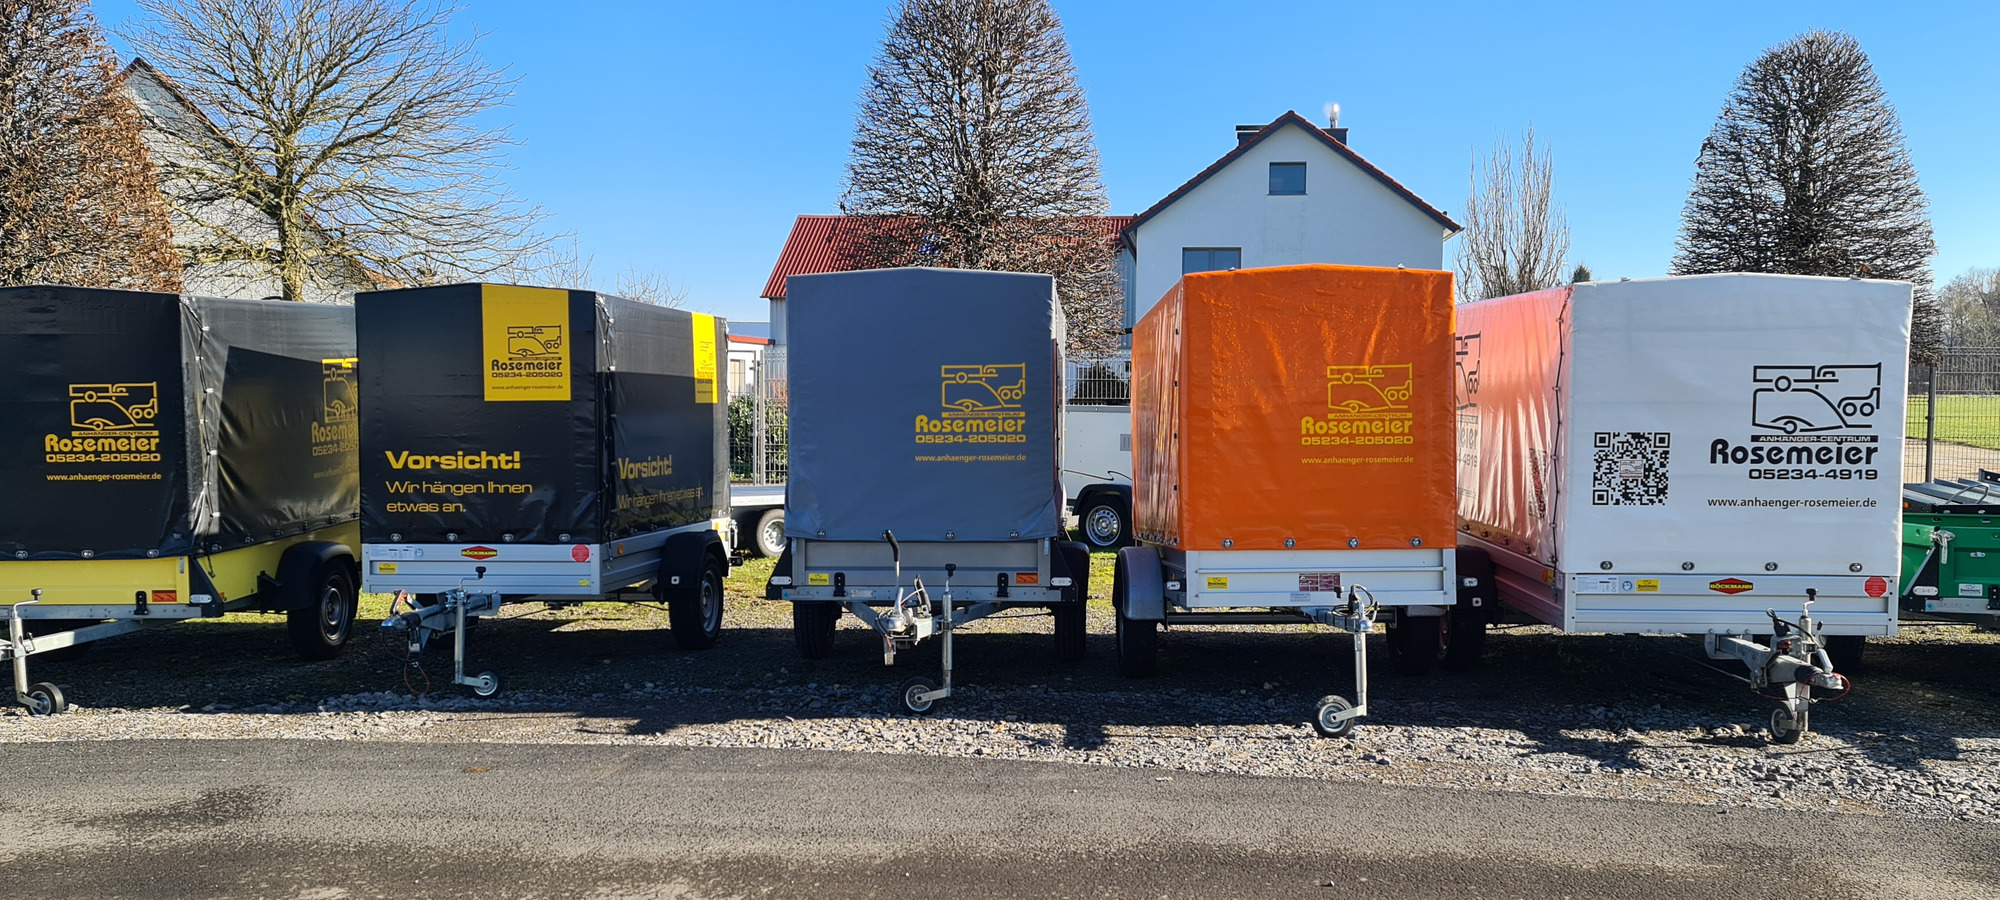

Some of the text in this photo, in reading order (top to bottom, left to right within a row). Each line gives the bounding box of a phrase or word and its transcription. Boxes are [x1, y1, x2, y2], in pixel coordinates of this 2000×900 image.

[492, 359, 562, 371] Rosemeier
[915, 415, 1026, 432] Rosemeier
[1301, 416, 1413, 434] Rosemeier
[45, 434, 160, 452] Rosemeier
[915, 434, 1026, 443] 05234-205020
[1302, 436, 1414, 445] 05234-205020
[46, 453, 161, 462] 05234-205020
[1710, 438, 1878, 465] Rosemeier
[385, 450, 521, 469] Vorsicht!
[915, 454, 1026, 462] www.anhaenger-rosemeier.de
[1301, 456, 1414, 465] www.anhaenger-rosemeier.de
[618, 454, 672, 480] Vorsicht!
[46, 472, 162, 482] www.anhaenger-rosemeier.de
[1749, 468, 1878, 480] 05234-4919
[385, 480, 533, 496] Wir hängen Ihnen
[386, 501, 467, 512] etwas an.
[616, 494, 632, 510] Wir
[1708, 497, 1877, 509] www.anhaenger-rosemeier.de
